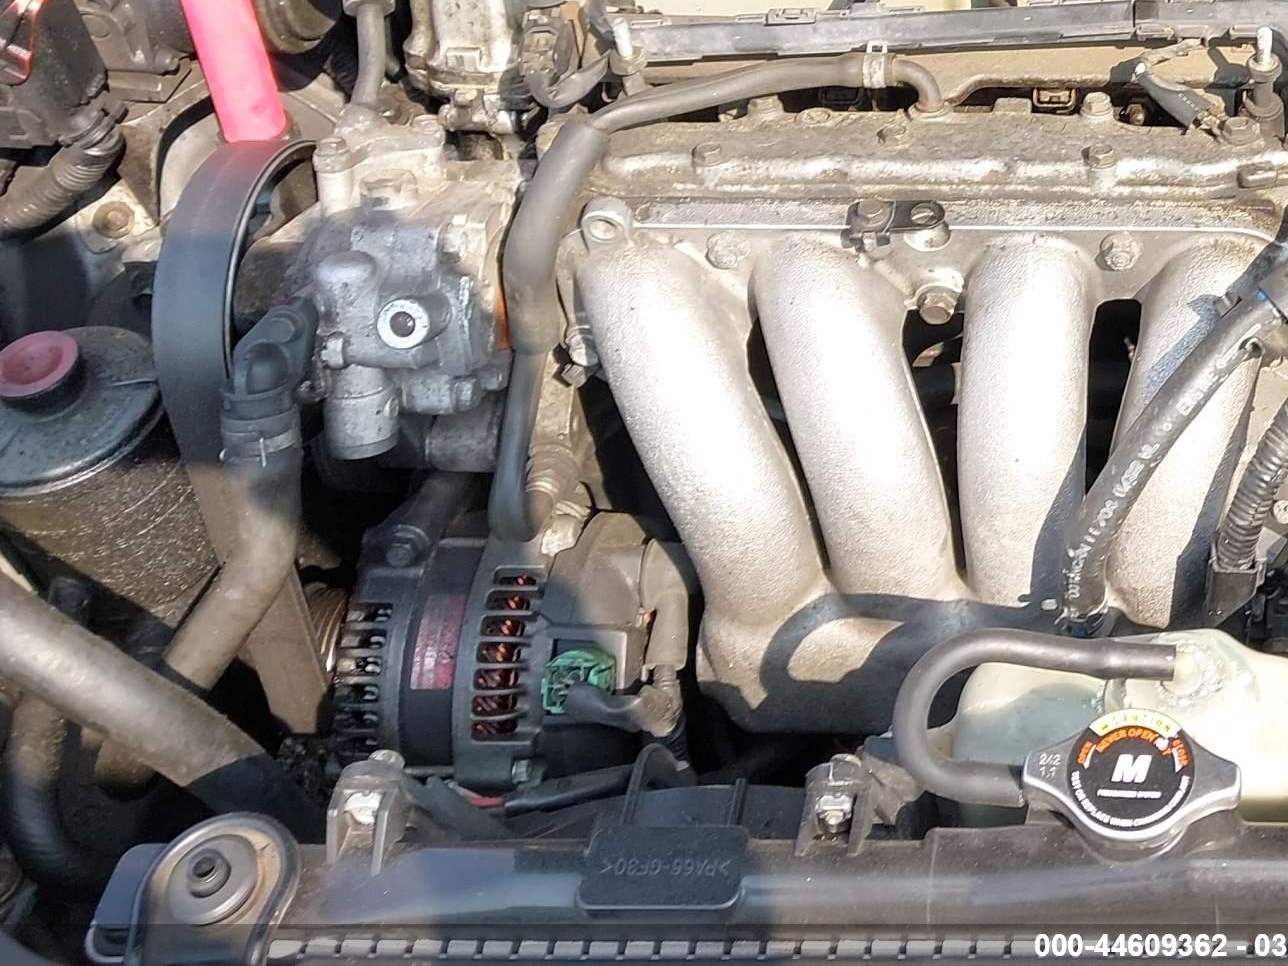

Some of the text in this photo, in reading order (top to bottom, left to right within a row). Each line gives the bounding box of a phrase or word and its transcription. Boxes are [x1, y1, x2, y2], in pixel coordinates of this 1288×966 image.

[1127, 728, 1159, 743] OPEN
[1111, 753, 1152, 784] M
[1081, 798, 1111, 824] REPLACE
